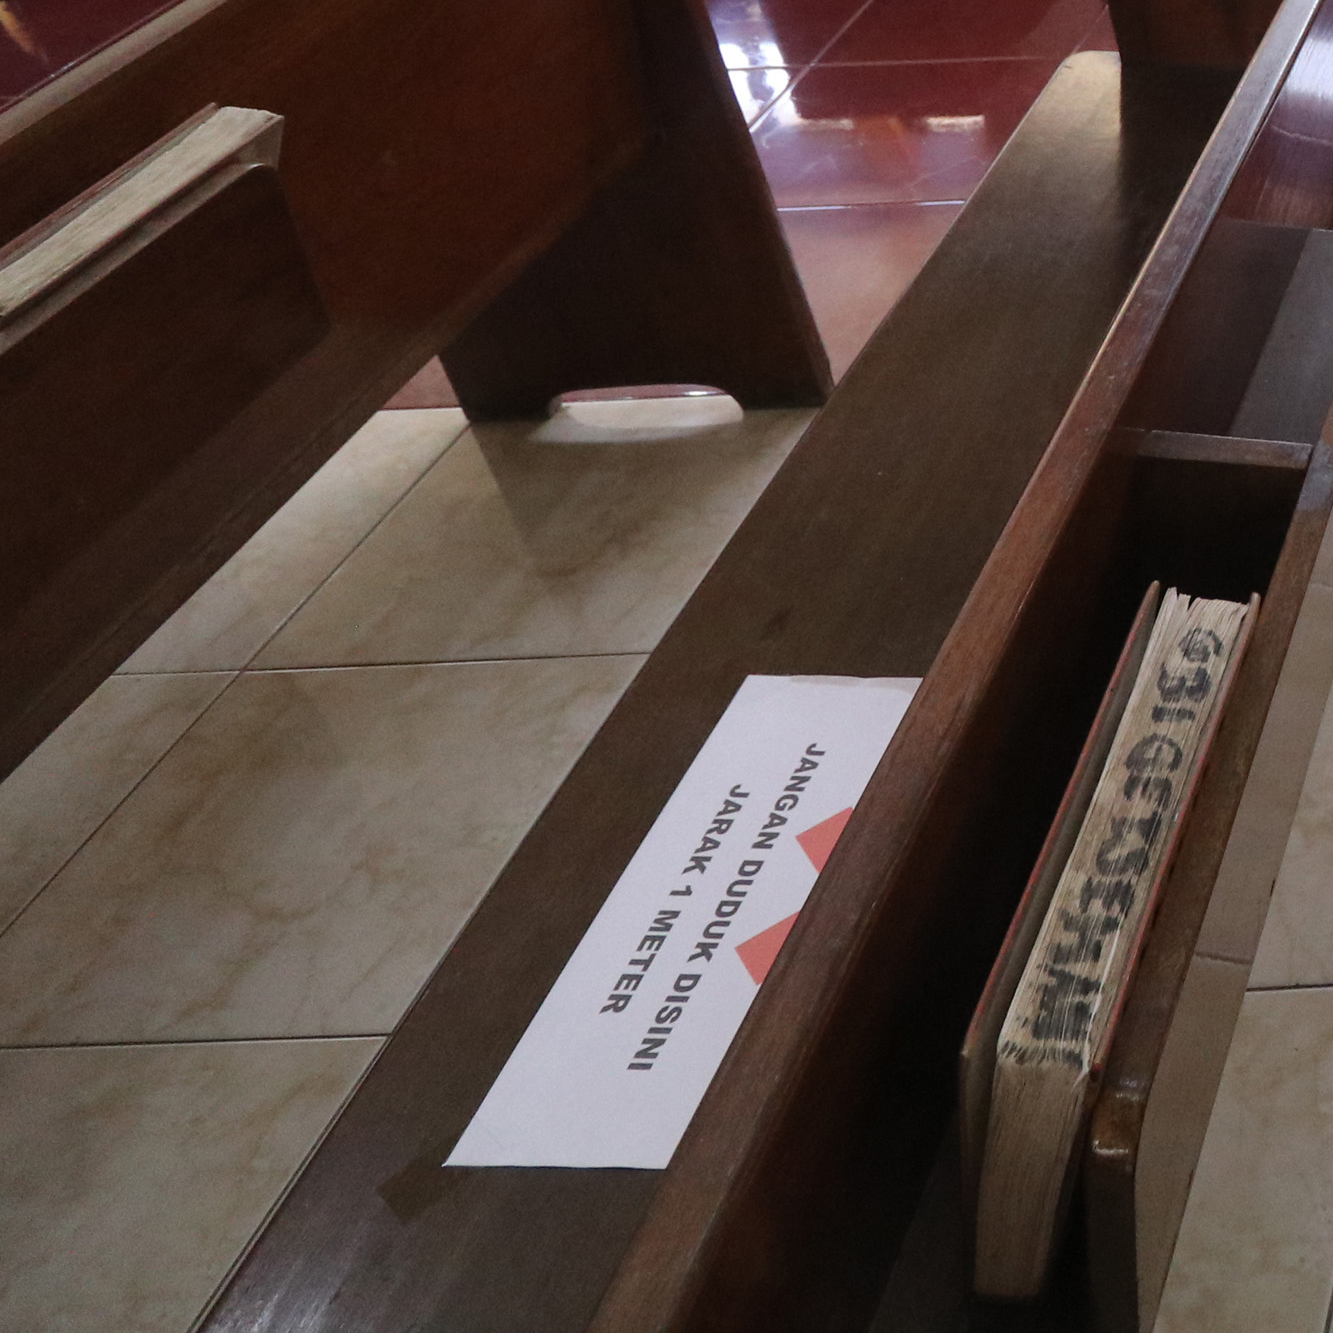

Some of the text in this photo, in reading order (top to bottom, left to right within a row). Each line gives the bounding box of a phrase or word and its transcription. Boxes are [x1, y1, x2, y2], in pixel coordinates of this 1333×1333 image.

[599, 784, 750, 1014] JARAK 1 METER
[627, 743, 826, 1071] JANGAN DUDUK DISINI
